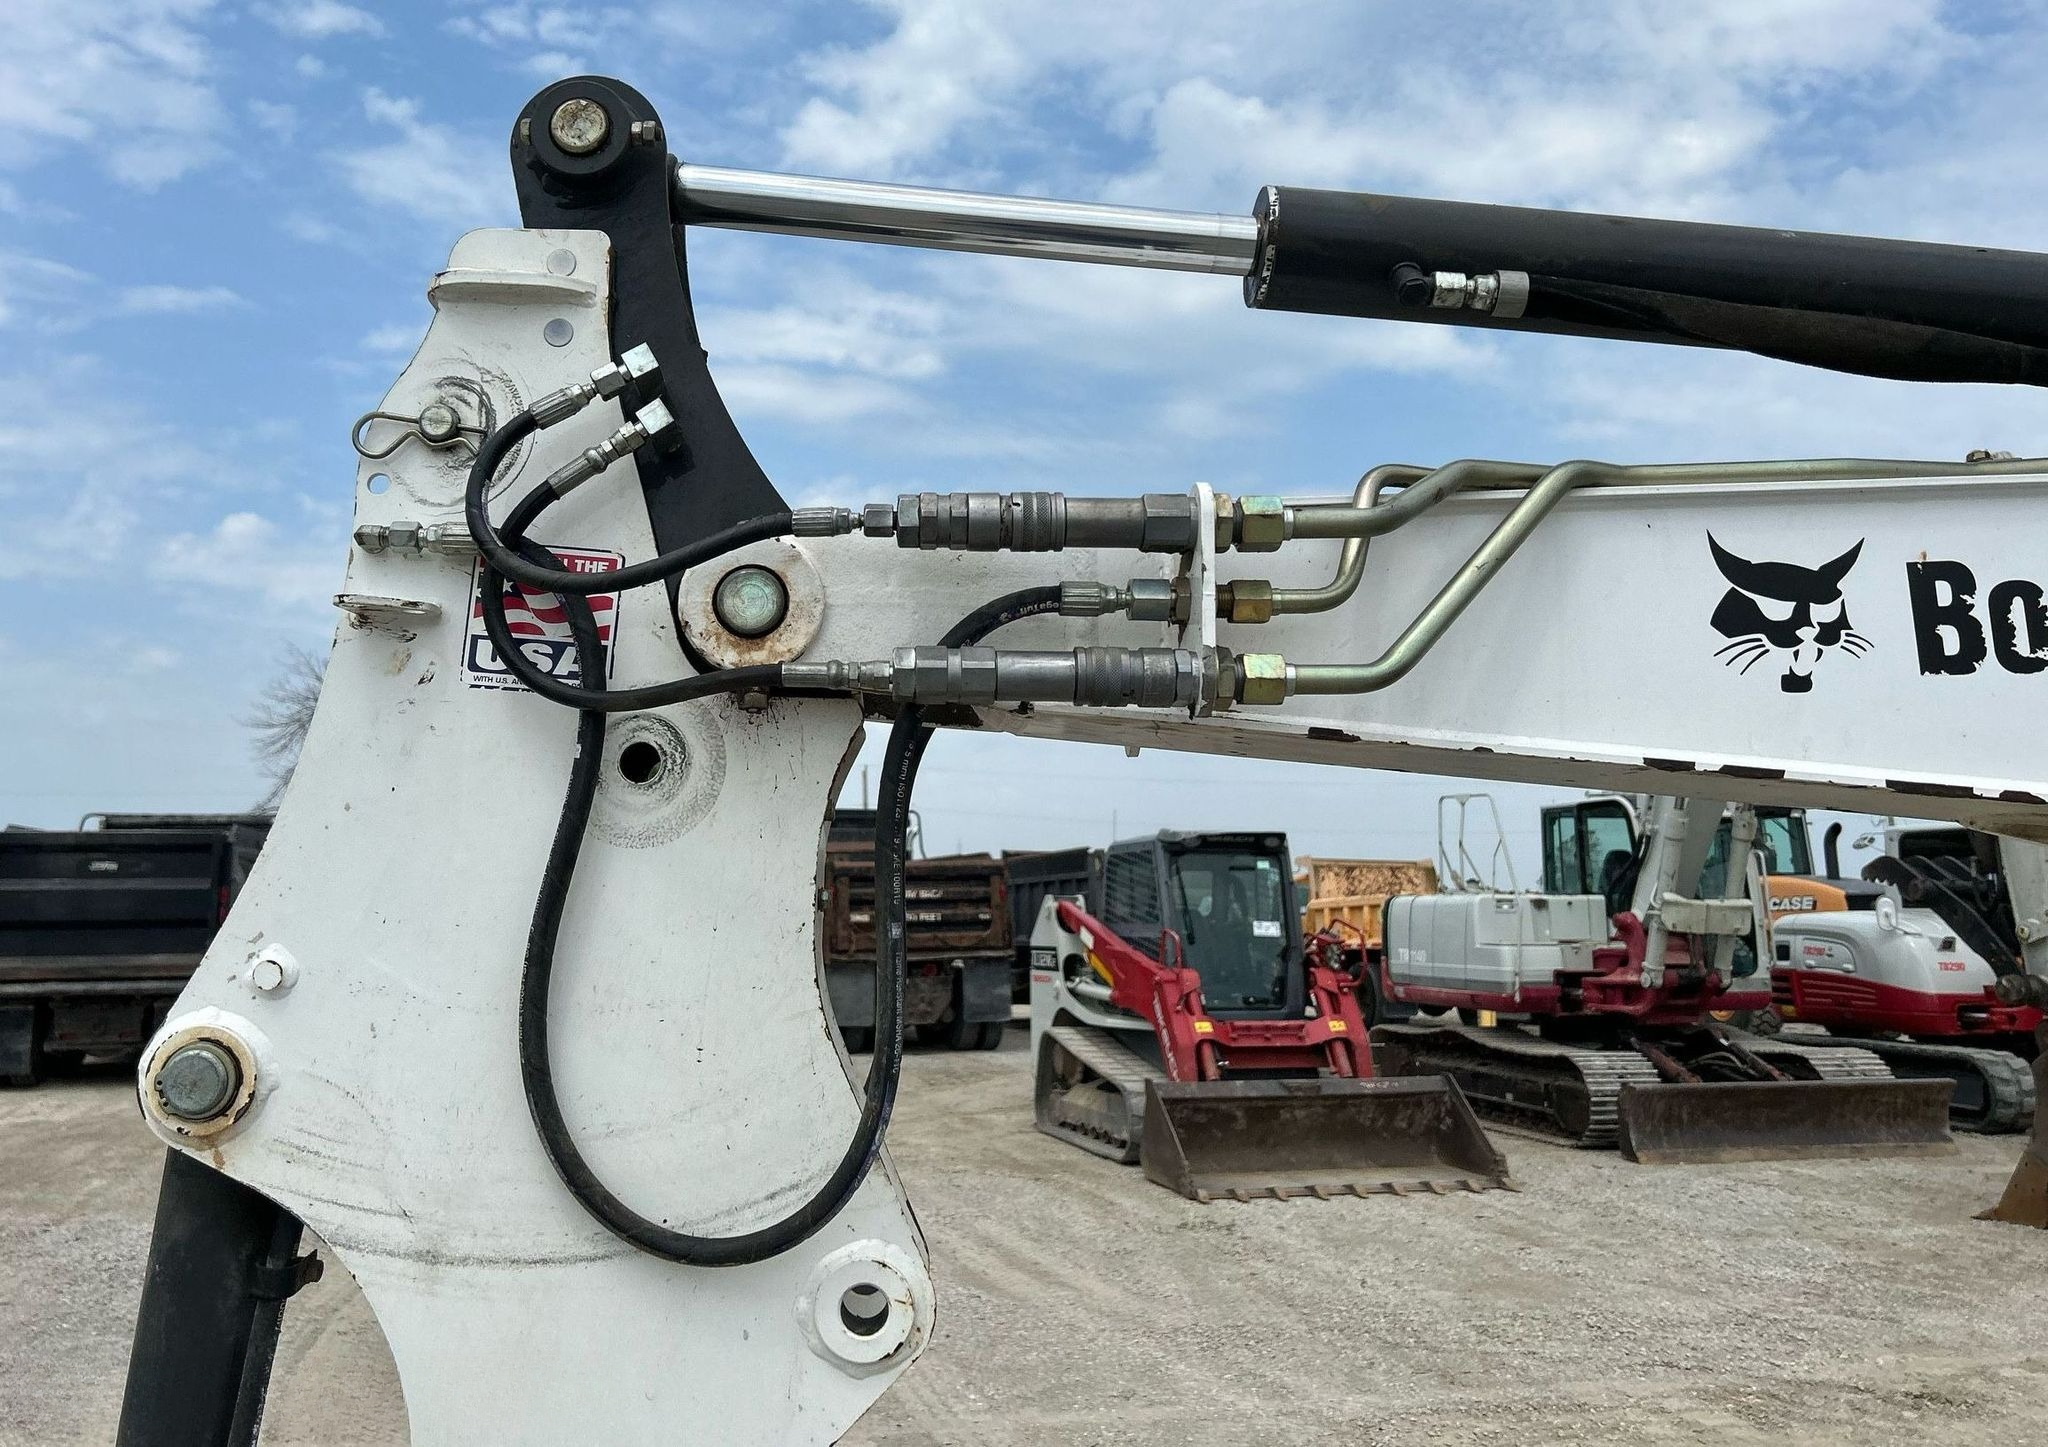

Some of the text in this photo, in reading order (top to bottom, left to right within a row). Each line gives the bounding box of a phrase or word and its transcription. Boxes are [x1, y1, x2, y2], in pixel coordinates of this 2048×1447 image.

[575, 559, 609, 573] THE
[473, 675, 493, 683] WITH
[1769, 896, 1815, 910] CASE
